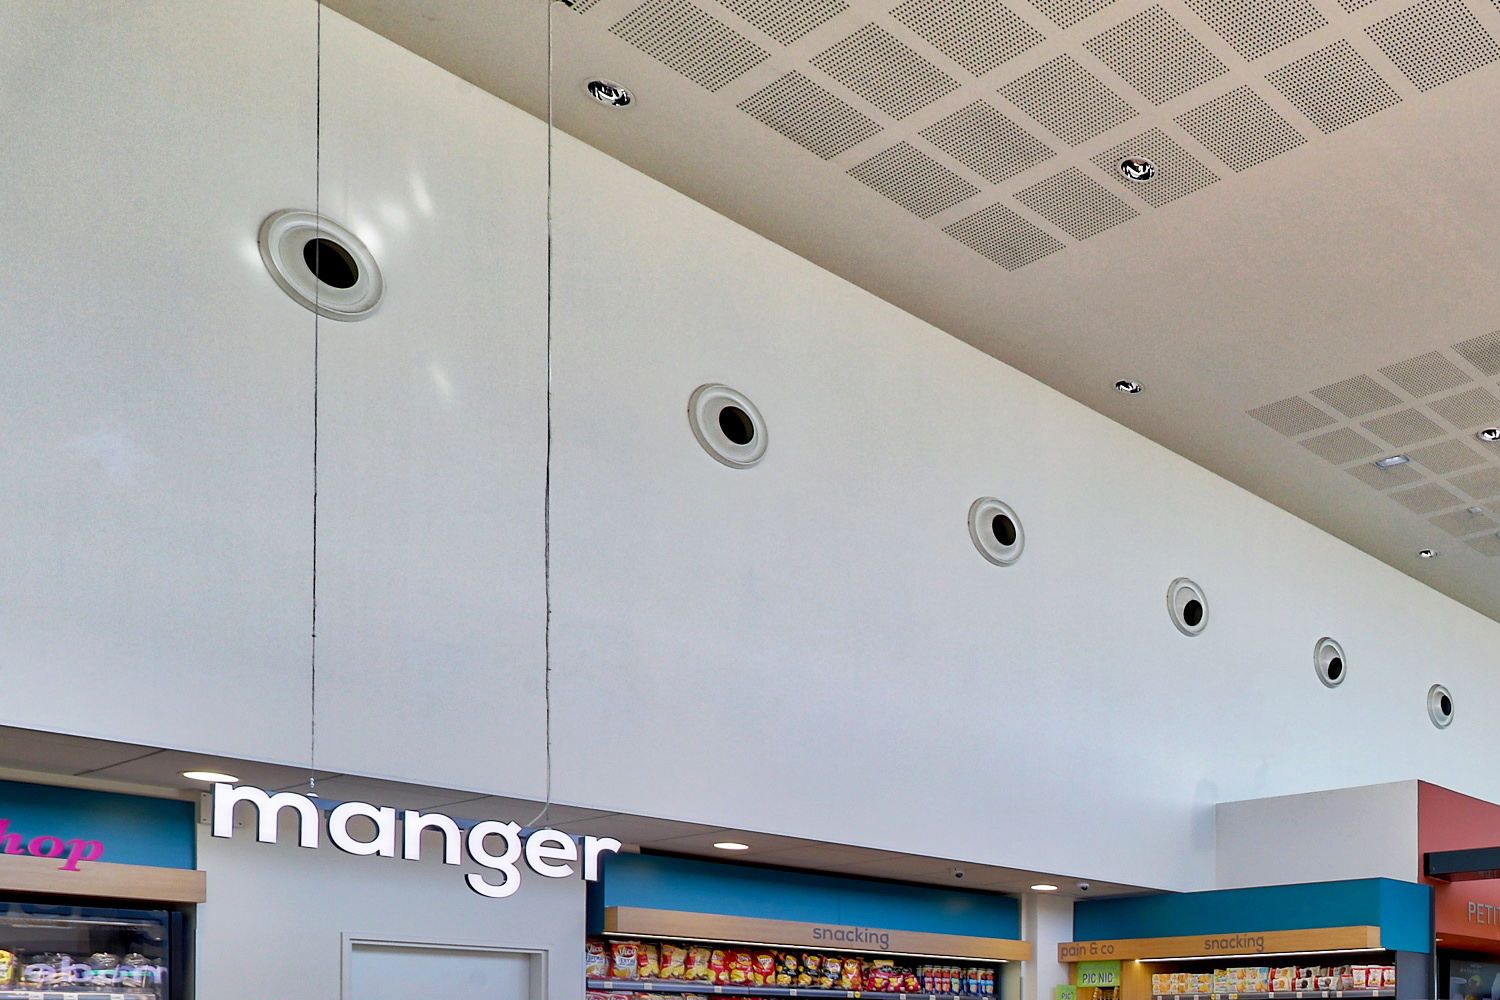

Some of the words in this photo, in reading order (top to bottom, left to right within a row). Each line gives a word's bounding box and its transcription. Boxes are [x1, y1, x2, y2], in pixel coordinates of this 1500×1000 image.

[210, 781, 622, 898] manger
[813, 927, 889, 950] snacking
[1204, 933, 1264, 953] snacking
[1061, 943, 1086, 959] pain
[1089, 942, 1097, 955] &
[1101, 943, 1114, 954] co
[1082, 973, 1096, 983] PIC
[1098, 972, 1113, 983] NIC
